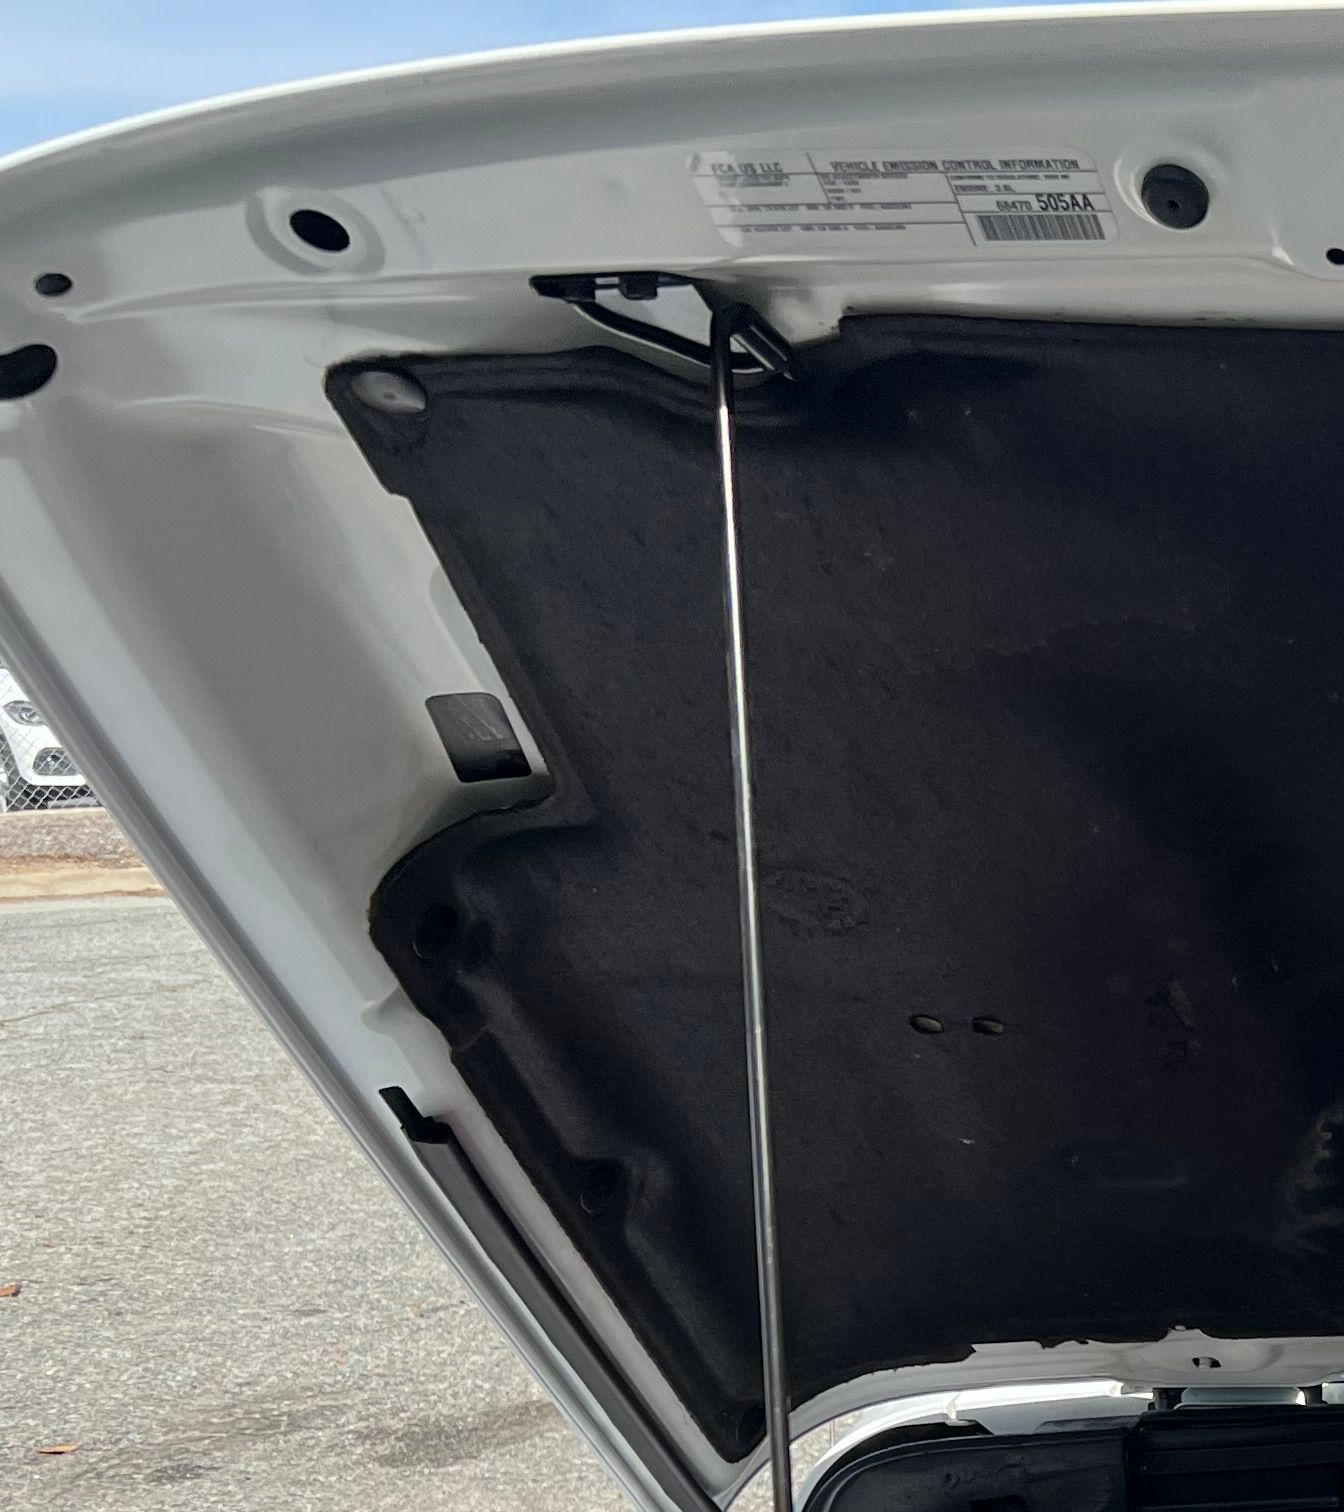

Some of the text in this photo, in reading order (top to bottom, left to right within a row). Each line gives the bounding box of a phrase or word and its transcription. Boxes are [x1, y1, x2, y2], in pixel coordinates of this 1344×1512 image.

[711, 162, 783, 175] FCA US LLC
[830, 159, 1081, 173] VEHICLE EMISSION CONTROL INFORMATION
[1035, 193, 1097, 212] 505AA
